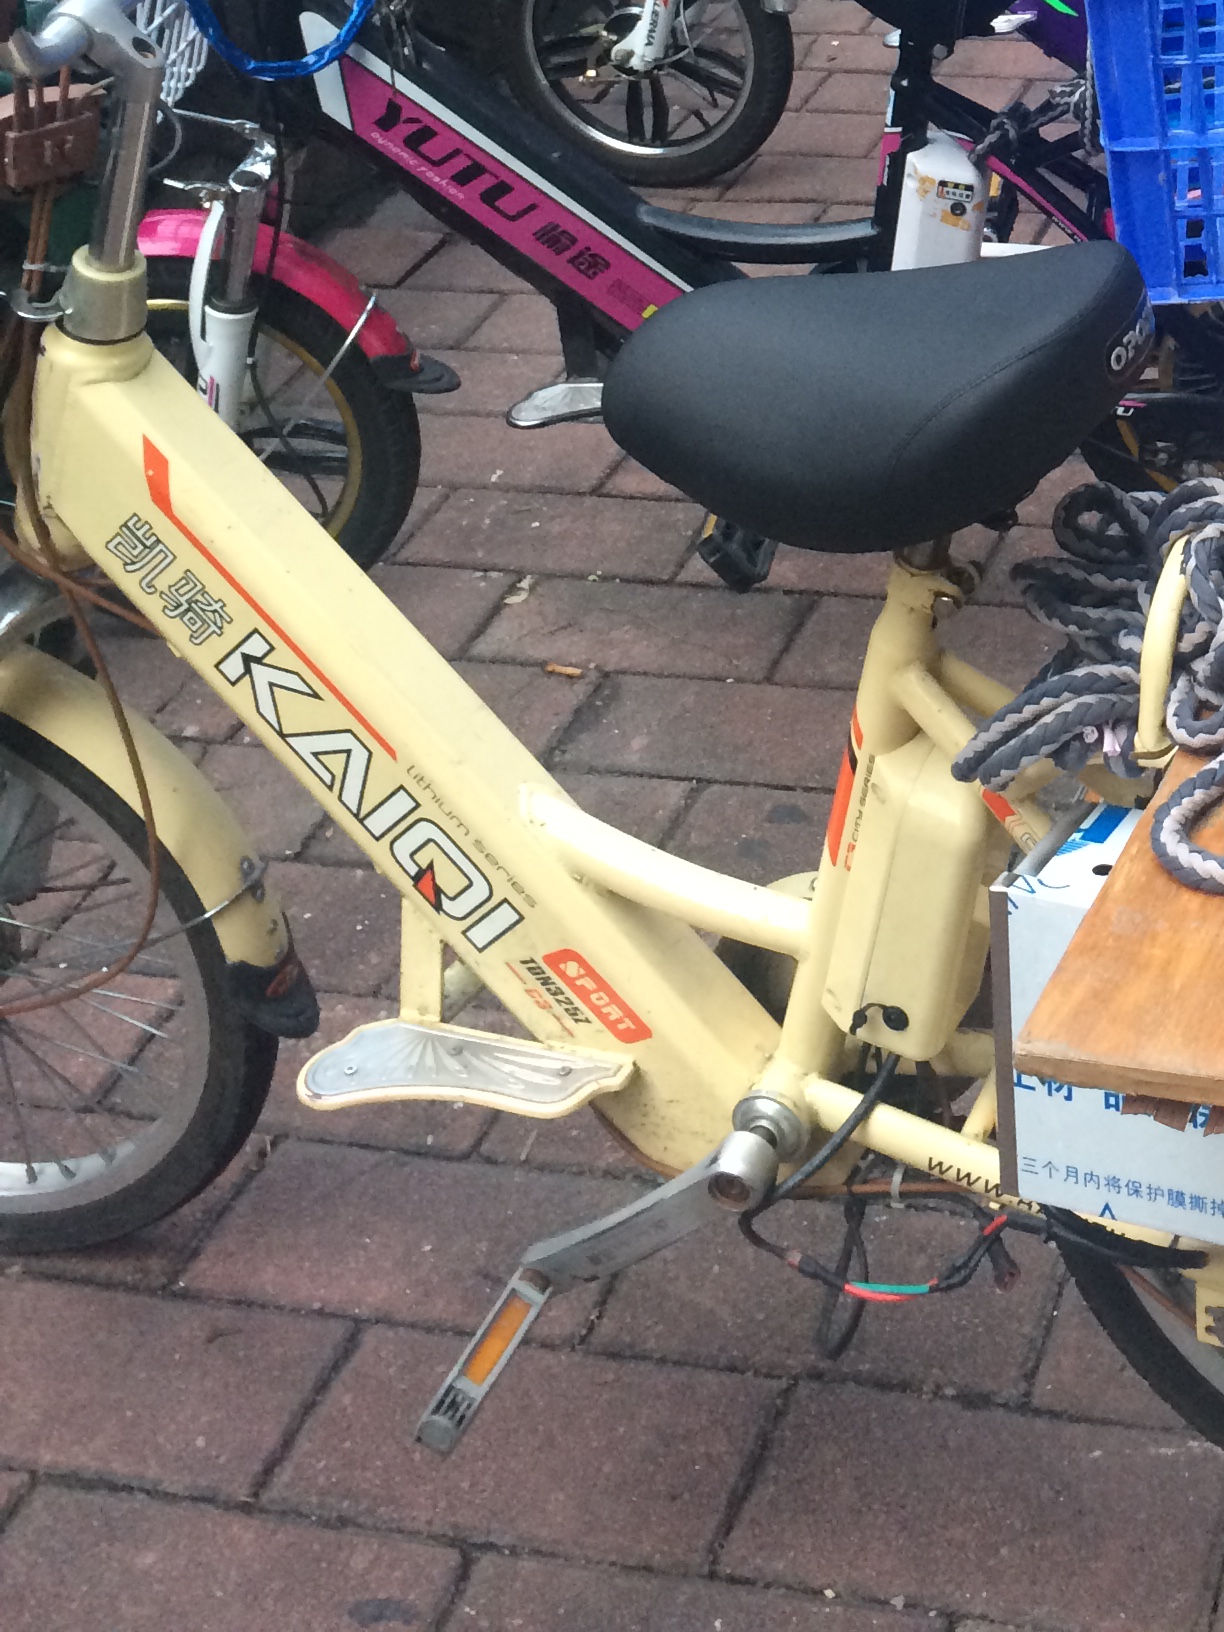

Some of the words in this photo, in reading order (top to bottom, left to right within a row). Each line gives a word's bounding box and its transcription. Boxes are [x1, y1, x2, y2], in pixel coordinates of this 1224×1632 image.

[372, 98, 540, 222] YUTU
[105, 512, 234, 647] 凯骑
[214, 628, 526, 954] KAIQI
[558, 960, 637, 1031] SPORT
